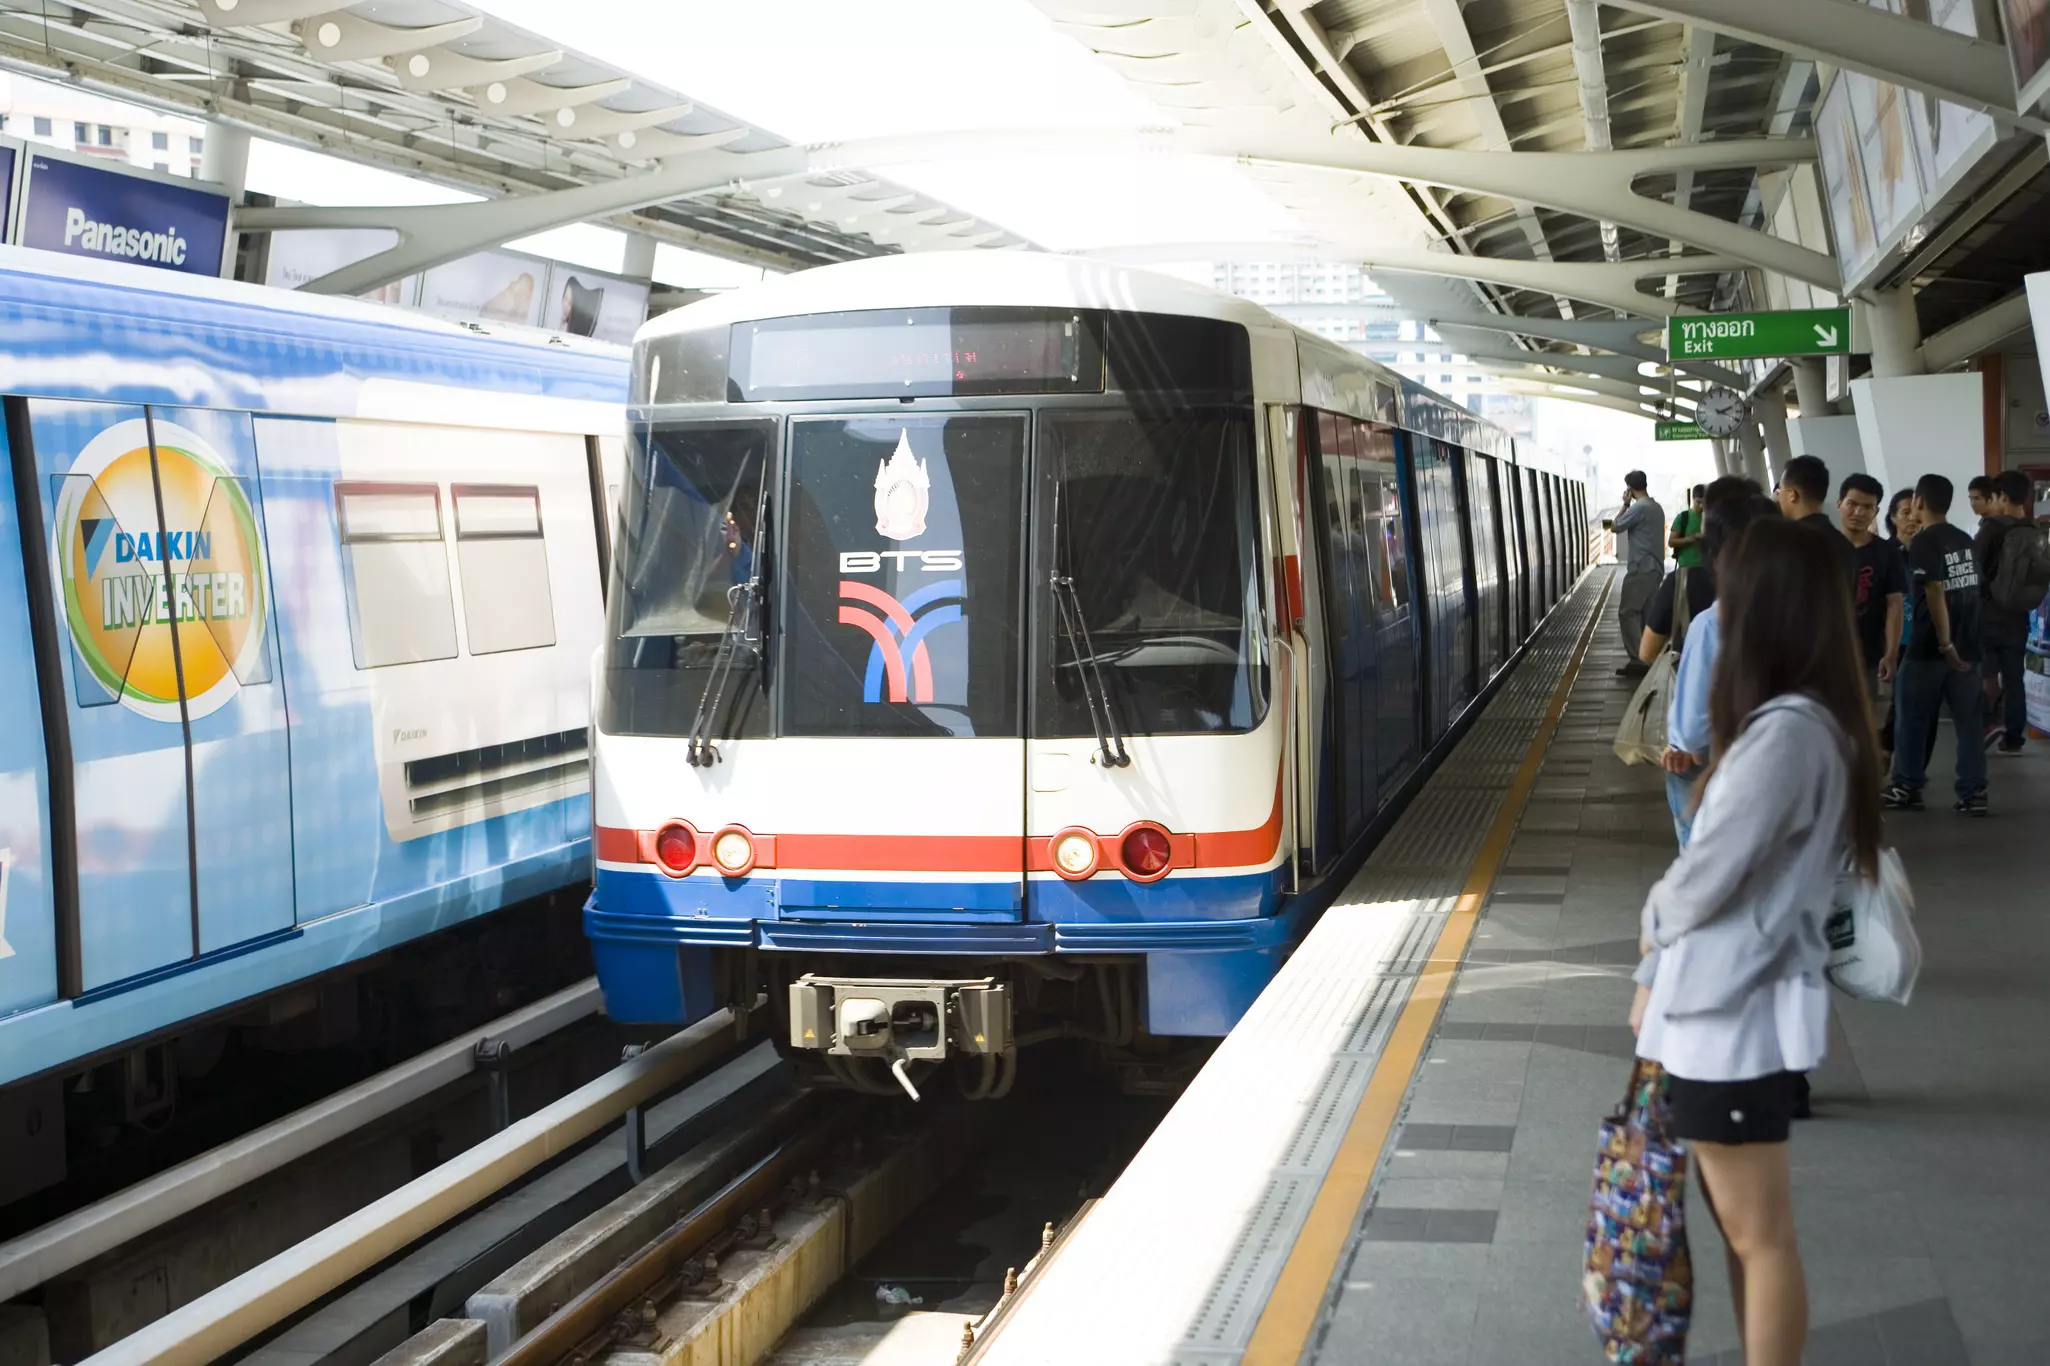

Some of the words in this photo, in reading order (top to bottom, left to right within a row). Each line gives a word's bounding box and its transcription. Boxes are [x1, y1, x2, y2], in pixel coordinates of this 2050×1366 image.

[64, 207, 187, 266] Panasonic
[1682, 320, 1755, 339] ทางออก
[1684, 340, 1713, 353] Exit
[115, 531, 211, 563] DAIKIN
[1944, 549, 1973, 566] DON
[839, 550, 963, 573] BTS
[102, 572, 246, 631] INVERTER
